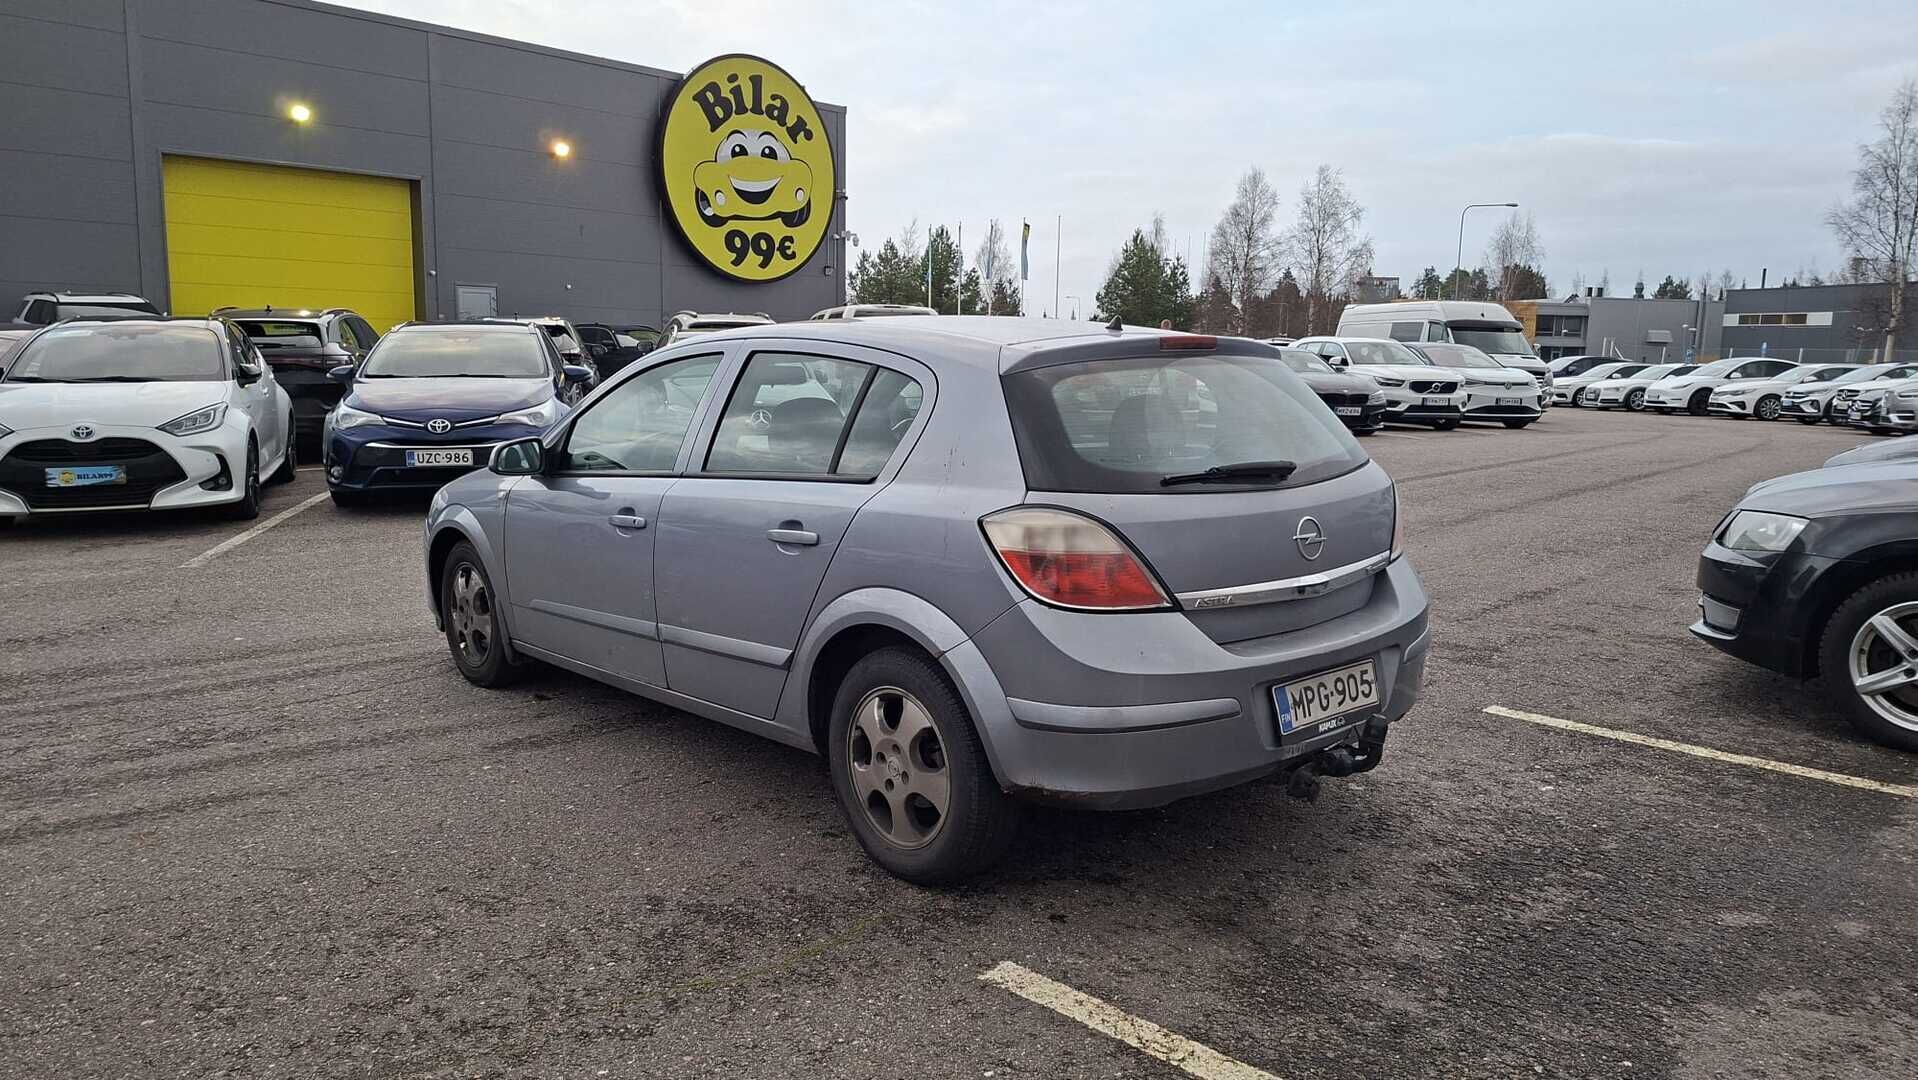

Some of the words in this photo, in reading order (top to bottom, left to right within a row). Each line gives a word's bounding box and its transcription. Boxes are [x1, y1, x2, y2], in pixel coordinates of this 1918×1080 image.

[692, 73, 814, 144] Bilar
[724, 229, 797, 269] 99€
[416, 452, 470, 464] UZC-986
[1194, 595, 1233, 608] ASTRA
[1291, 669, 1373, 721] MPG-905
